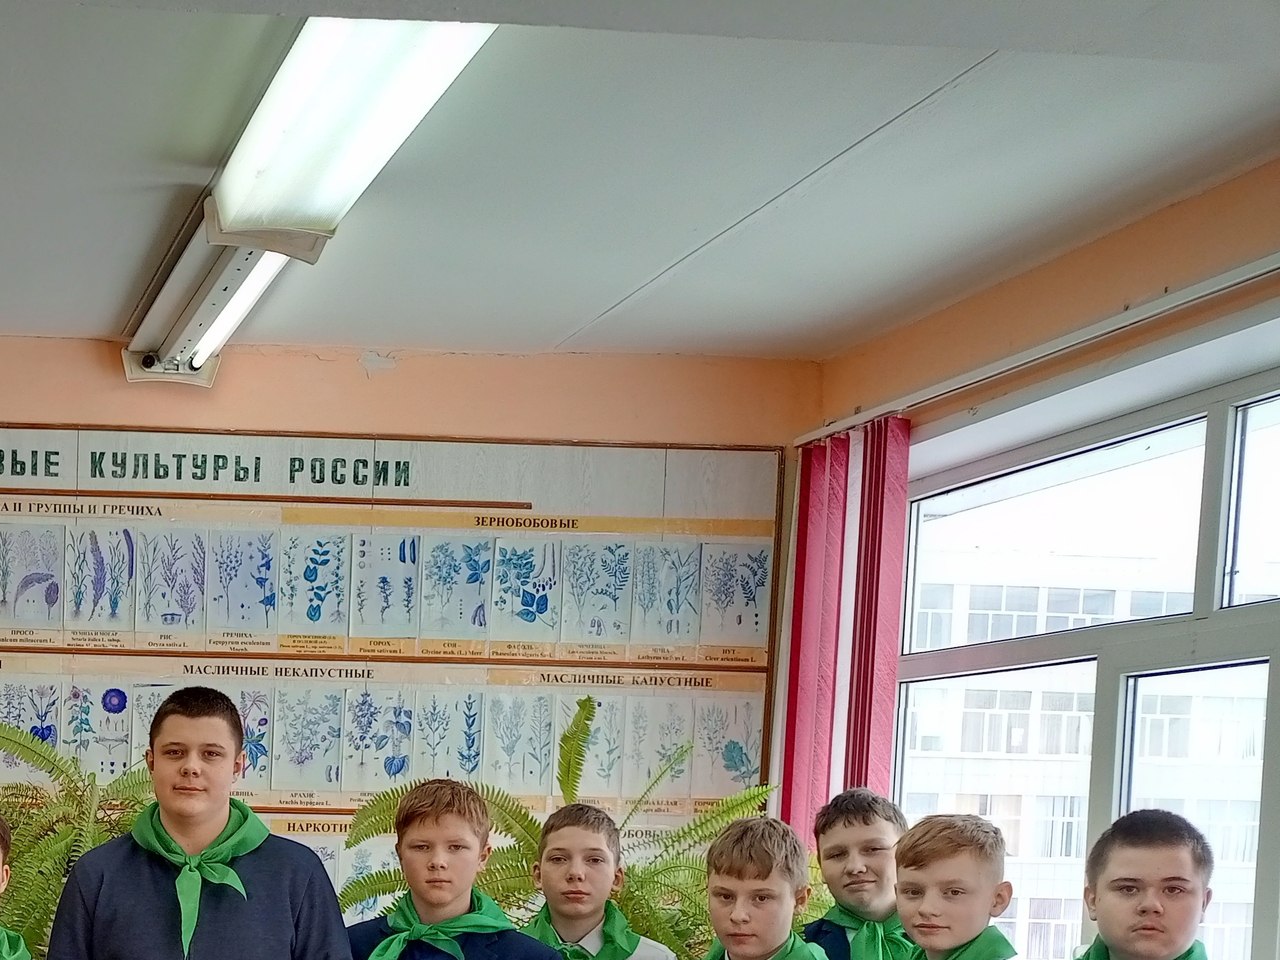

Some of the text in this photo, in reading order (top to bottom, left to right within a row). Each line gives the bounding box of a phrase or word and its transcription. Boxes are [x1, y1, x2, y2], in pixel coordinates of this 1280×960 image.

[90, 451, 261, 483] КУЛЬТУРЫ
[289, 457, 410, 487] РОССИИ
[13, 502, 22, 513] II
[28, 503, 84, 515] ГРУППЫ
[87, 503, 97, 514] И
[102, 504, 163, 517] ГРЕЧИХА
[474, 516, 579, 529] ЗЕРНОБОБОВЫЕ
[222, 632, 253, 640] ГРЕЧИХА
[148, 641, 165, 649] Oryza
[369, 640, 391, 648] ГОРОХ
[183, 665, 374, 679] МАСЛИЧНЫЕ НЕКАПУСТНЫЕ
[540, 673, 712, 687] МАСЛИЧНЫЕ КАПУСТНЫЕ
